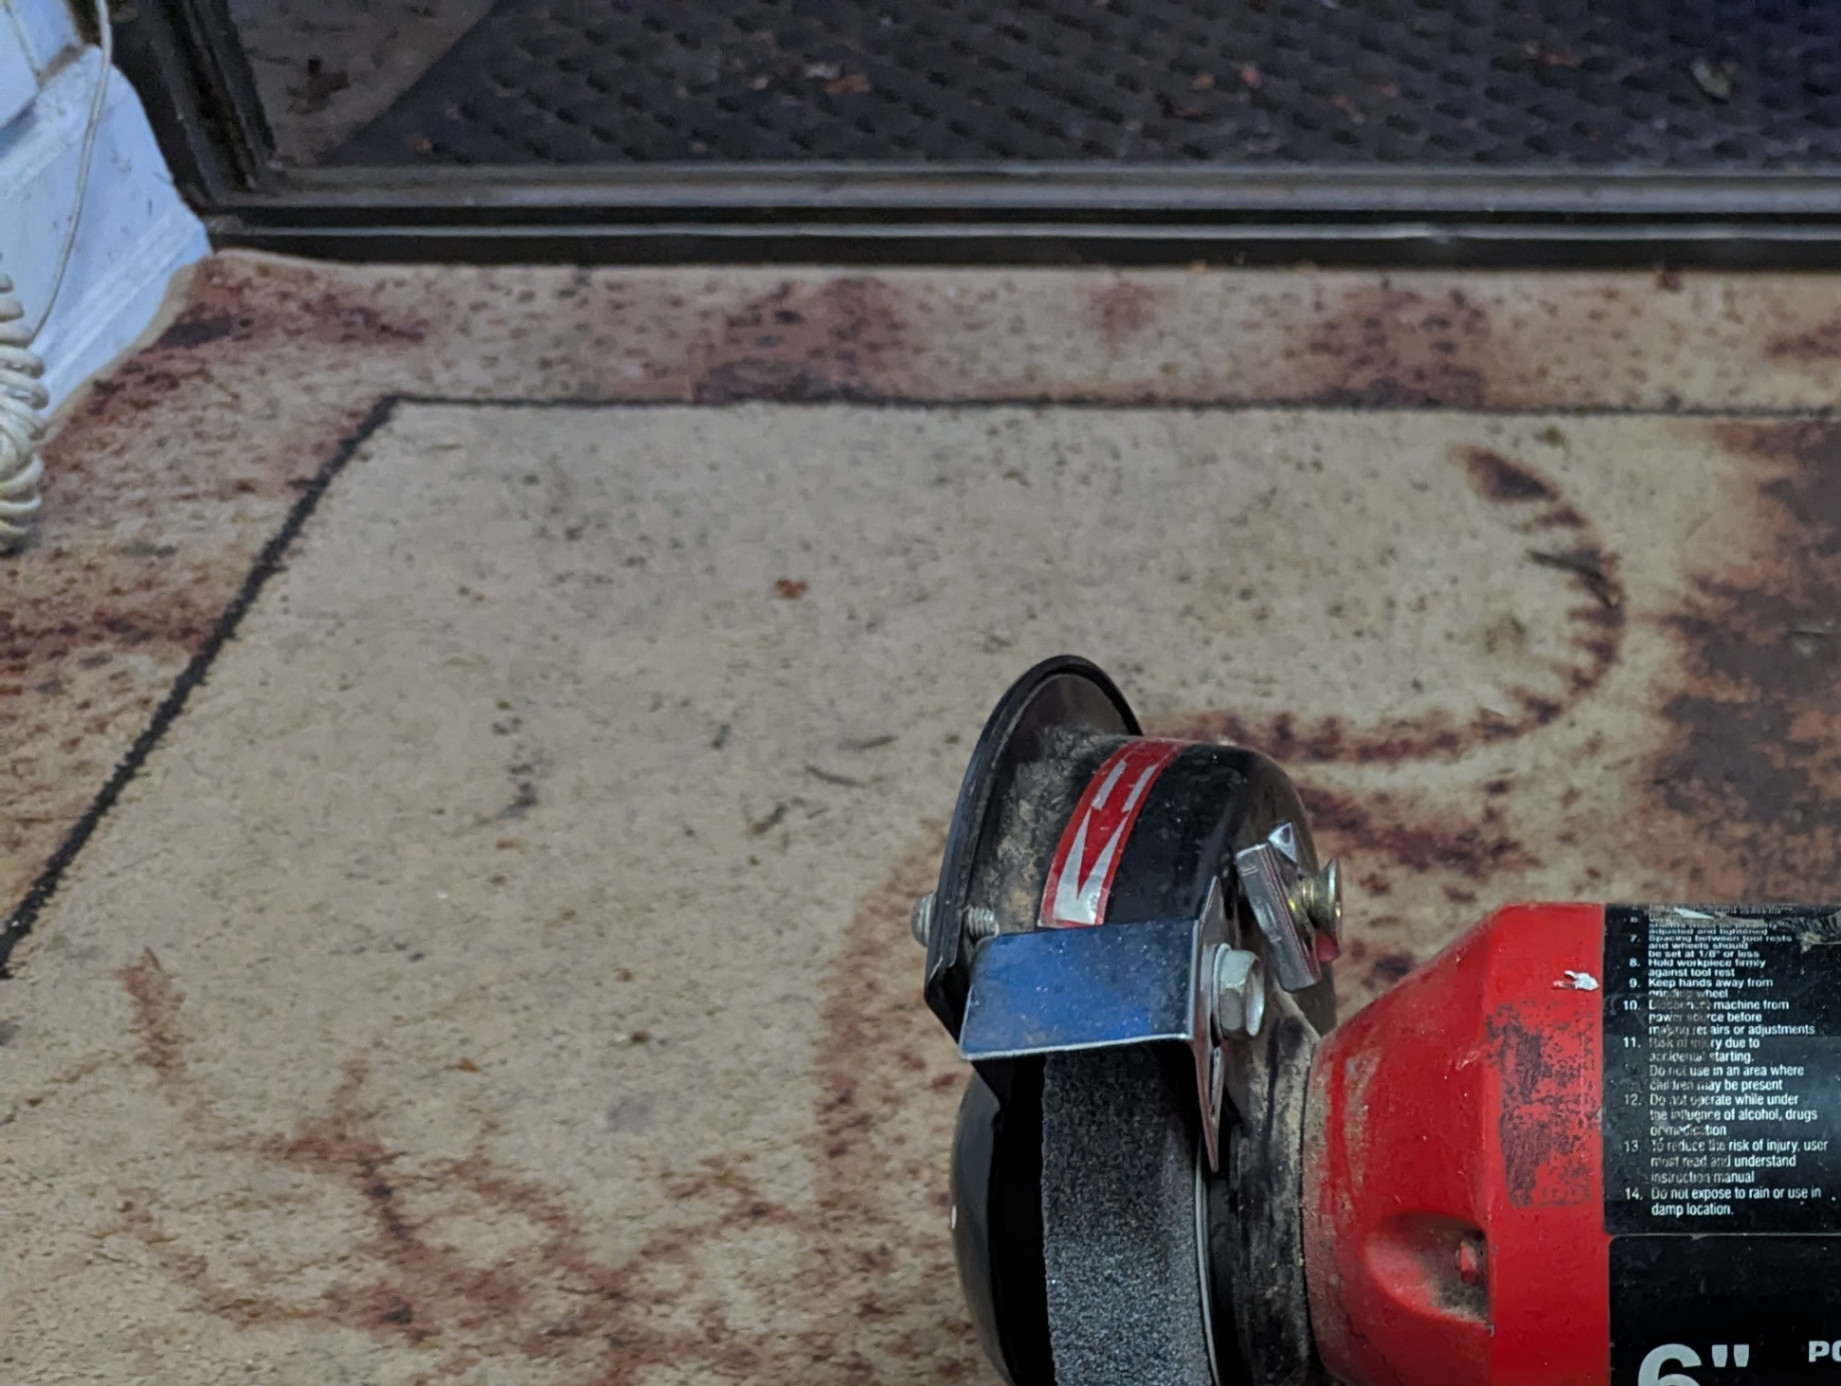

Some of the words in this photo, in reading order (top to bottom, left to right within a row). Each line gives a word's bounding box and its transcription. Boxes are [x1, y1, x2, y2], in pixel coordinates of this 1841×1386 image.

[1629, 959, 1640, 967] 8.
[1649, 959, 1673, 967] Hold
[1677, 959, 1732, 968] workpiece
[1735, 959, 1766, 969] firmly
[1649, 969, 1687, 977] against
[1630, 979, 1640, 987] 9.
[1649, 979, 1676, 988] Keep
[1679, 979, 1712, 987] hands
[1716, 979, 1744, 988] away
[1624, 1001, 1640, 1010] 10.
[1714, 1000, 1760, 1009] machine
[1763, 1000, 1789, 1009] from
[1728, 1013, 1762, 1022] before
[1734, 1026, 1744, 1034] or
[1749, 1025, 1815, 1037] adjustments
[1623, 1038, 1641, 1047] 11.
[1725, 1038, 1745, 1048] due
[1749, 1038, 1760, 1048] to
[1650, 1066, 1665, 1076] Do
[1690, 1067, 1710, 1076] use
[1713, 1066, 1723, 1075] in
[1727, 1067, 1740, 1075] an
[1743, 1067, 1766, 1075] area
[1771, 1066, 1804, 1075] where
[1725, 1080, 1738, 1090] be
[1742, 1080, 1782, 1093] present
[1624, 1095, 1642, 1105] 12.
[1735, 1094, 1763, 1105] while
[1767, 1094, 1798, 1105] under
[1724, 1109, 1735, 1120] of
[1739, 1109, 1782, 1122] alcohol,
[1785, 1108, 1818, 1122] drugs
[1667, 1140, 1705, 1150] reduce
[1729, 1139, 1749, 1150] risk
[1753, 1139, 1763, 1150] of
[1804, 1141, 1828, 1150] user
[1734, 1155, 1796, 1166] understand
[1714, 1171, 1755, 1183] manual
[1625, 1188, 1643, 1200] 14.
[1652, 1188, 1667, 1199] Do
[1671, 1189, 1689, 1199] not
[1692, 1190, 1731, 1201] expose
[1735, 1189, 1745, 1199] to
[1749, 1188, 1770, 1199] rain
[1773, 1189, 1784, 1199] or
[1788, 1189, 1808, 1199] use
[1811, 1187, 1821, 1198] in
[1652, 1204, 1683, 1218] damp
[1687, 1204, 1733, 1215] location.
